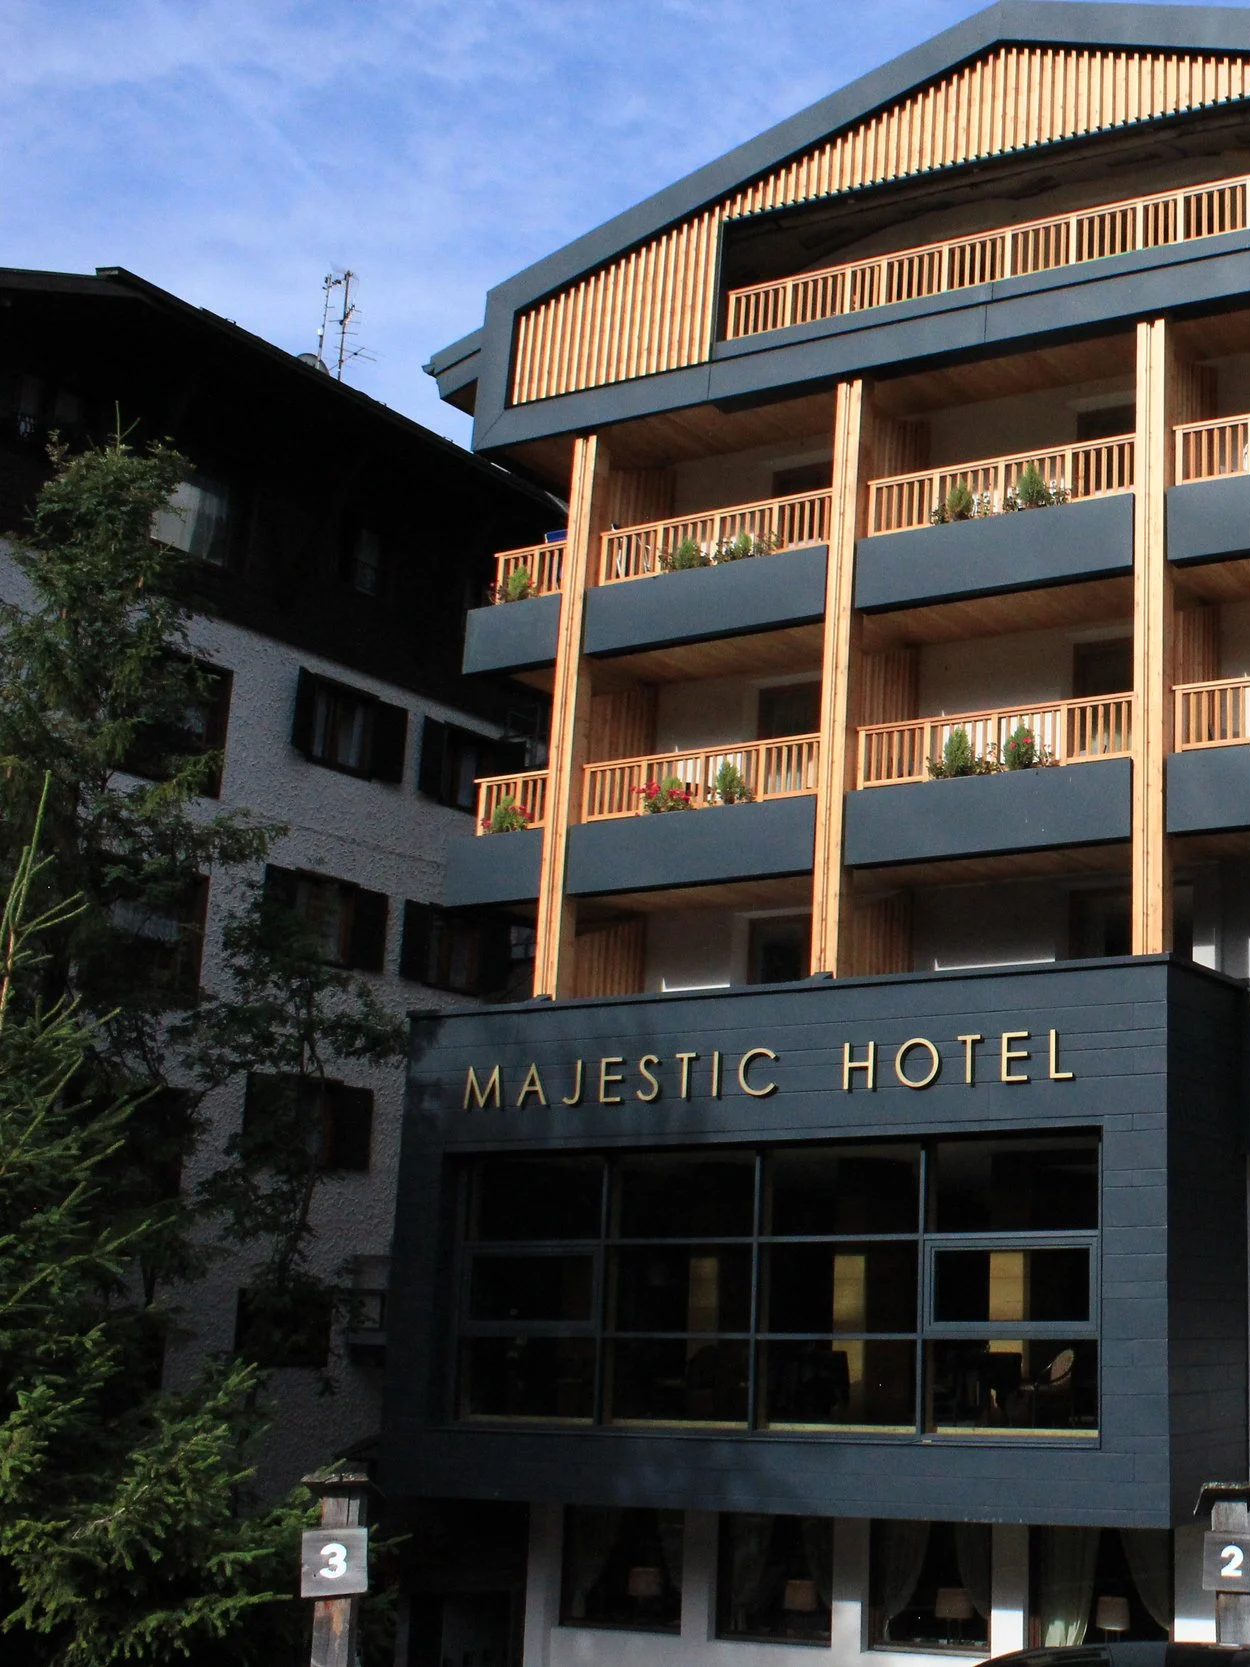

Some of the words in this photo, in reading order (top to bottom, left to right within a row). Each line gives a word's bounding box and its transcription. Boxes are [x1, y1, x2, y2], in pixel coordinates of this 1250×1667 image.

[463, 1047, 777, 1109] MAJESTIC
[842, 1029, 1074, 1091] HOTEL
[319, 1543, 347, 1578] 3
[1220, 1545, 1243, 1577] 2
